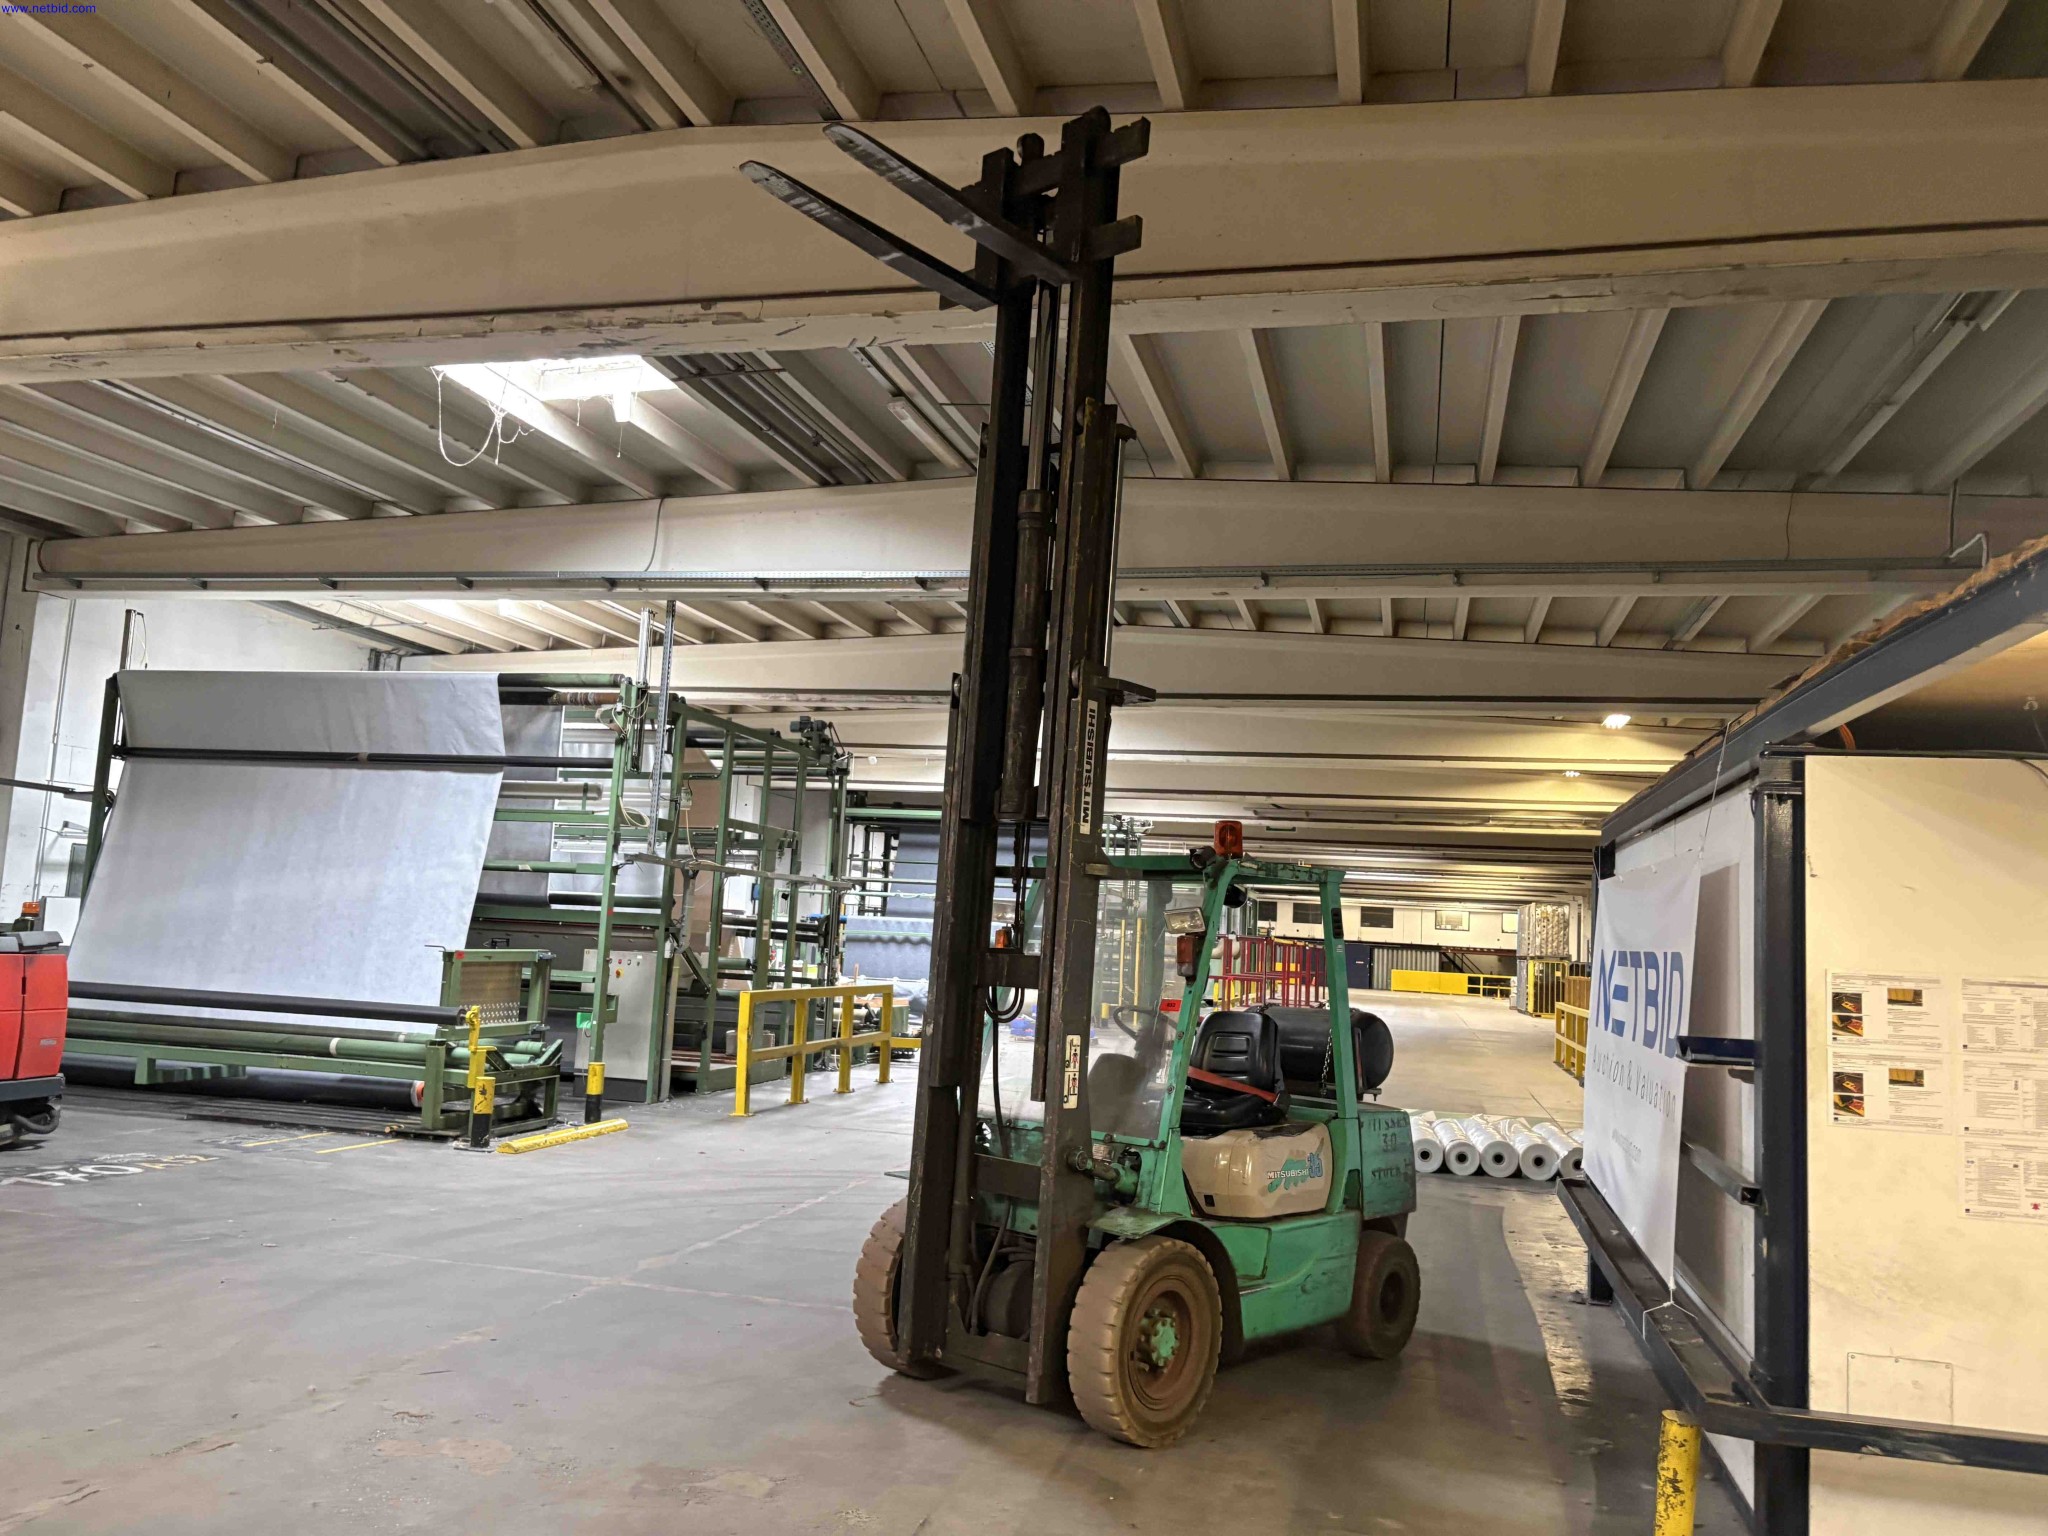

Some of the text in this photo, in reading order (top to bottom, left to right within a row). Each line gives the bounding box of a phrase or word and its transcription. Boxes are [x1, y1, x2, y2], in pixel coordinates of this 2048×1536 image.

[1082, 708, 1096, 824] MITSUBISHI
[1595, 948, 1684, 1059] NETBID
[1626, 1059, 1633, 1092] &
[1635, 1062, 1677, 1123] Valuation
[1267, 1168, 1309, 1180] MITSUBISHI
